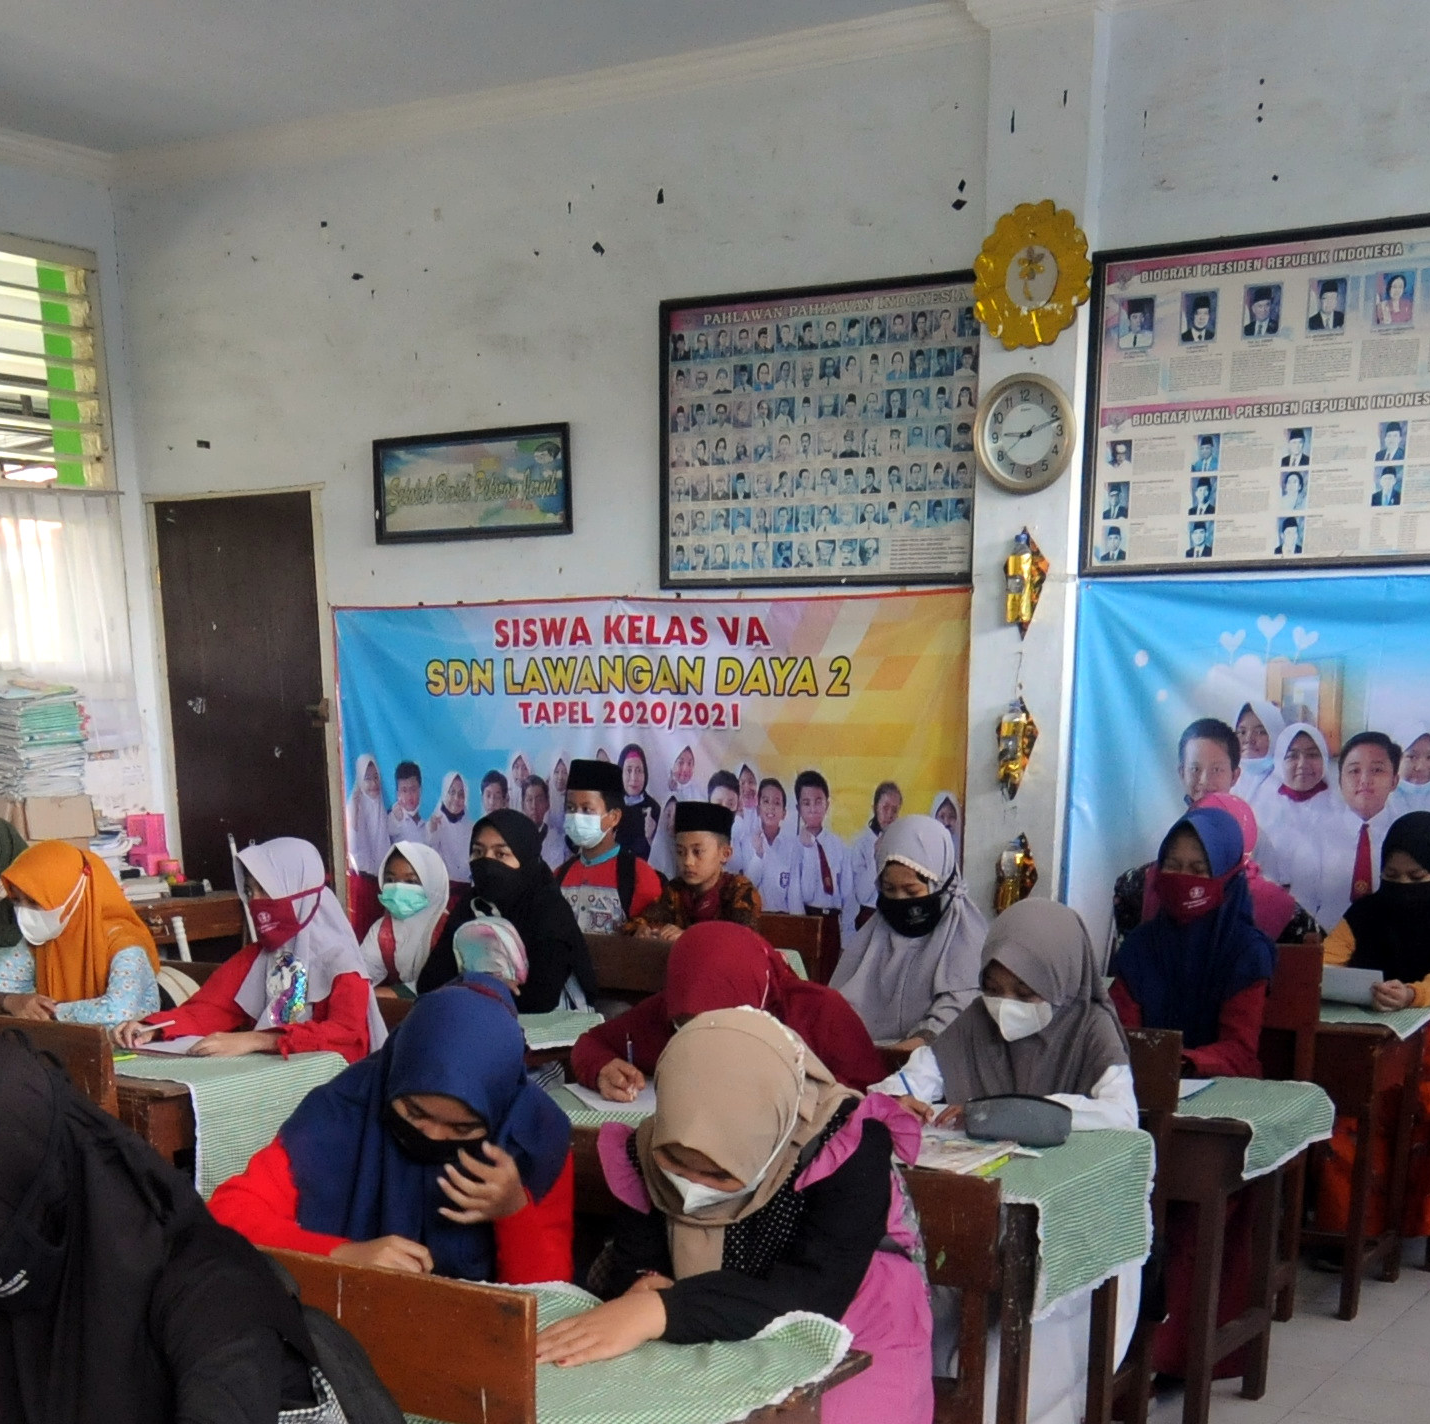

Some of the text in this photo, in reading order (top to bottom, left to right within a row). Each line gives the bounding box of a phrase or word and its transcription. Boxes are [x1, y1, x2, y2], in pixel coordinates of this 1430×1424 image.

[1140, 243, 1404, 283] BIOGRAFI PRESIDEN REPUBLIK INDONESIA
[703, 288, 969, 326] PAHLAWAN PAHLAWAN INDONESIA
[1132, 410, 1189, 427] BIOGRAFI
[1193, 407, 1232, 422] WAKIL
[1236, 401, 1299, 419] PRESIDEN
[1302, 396, 1368, 415] REPUBLIK
[494, 614, 771, 647] SISWA KELAS VA
[426, 655, 851, 696] SDN LAWANGAN DAYA 2
[519, 701, 740, 730] TAPEL 2020/2021
